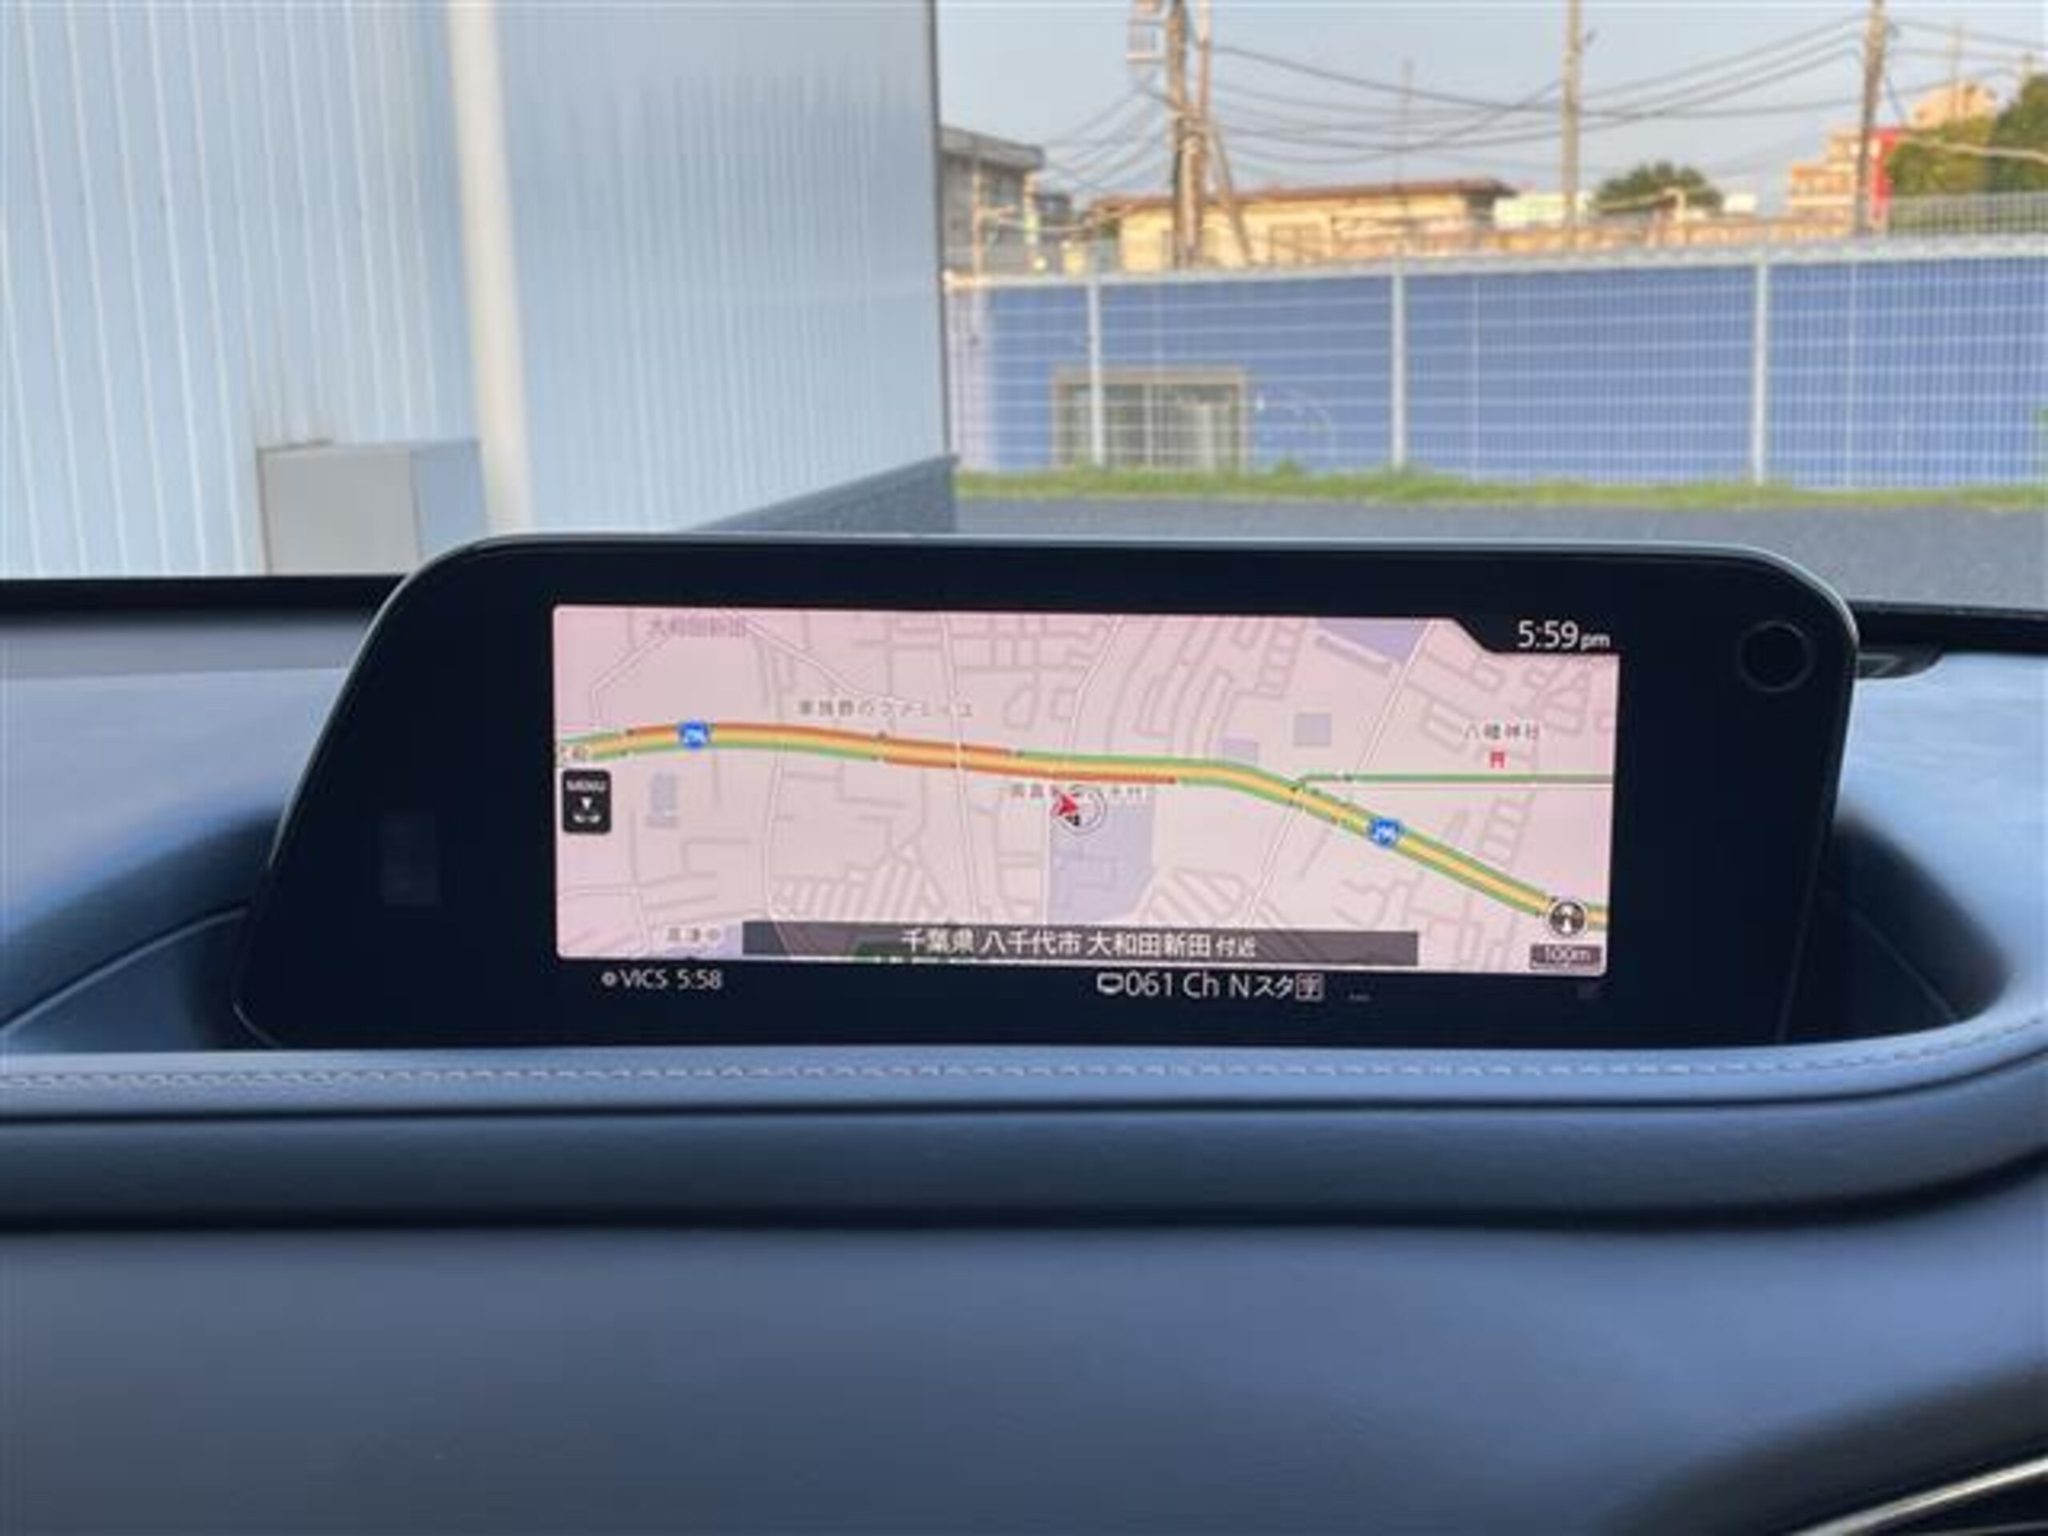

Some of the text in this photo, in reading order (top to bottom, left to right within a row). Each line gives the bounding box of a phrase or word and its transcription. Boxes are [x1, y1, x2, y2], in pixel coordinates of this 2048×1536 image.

[901, 927, 975, 952] 千葉県
[979, 929, 1082, 955] 八千代市
[1087, 930, 1211, 957] 大和田新田
[619, 969, 723, 990] VICS 5:58
[1124, 970, 1172, 998] 061
[1182, 970, 1221, 999] Ch
